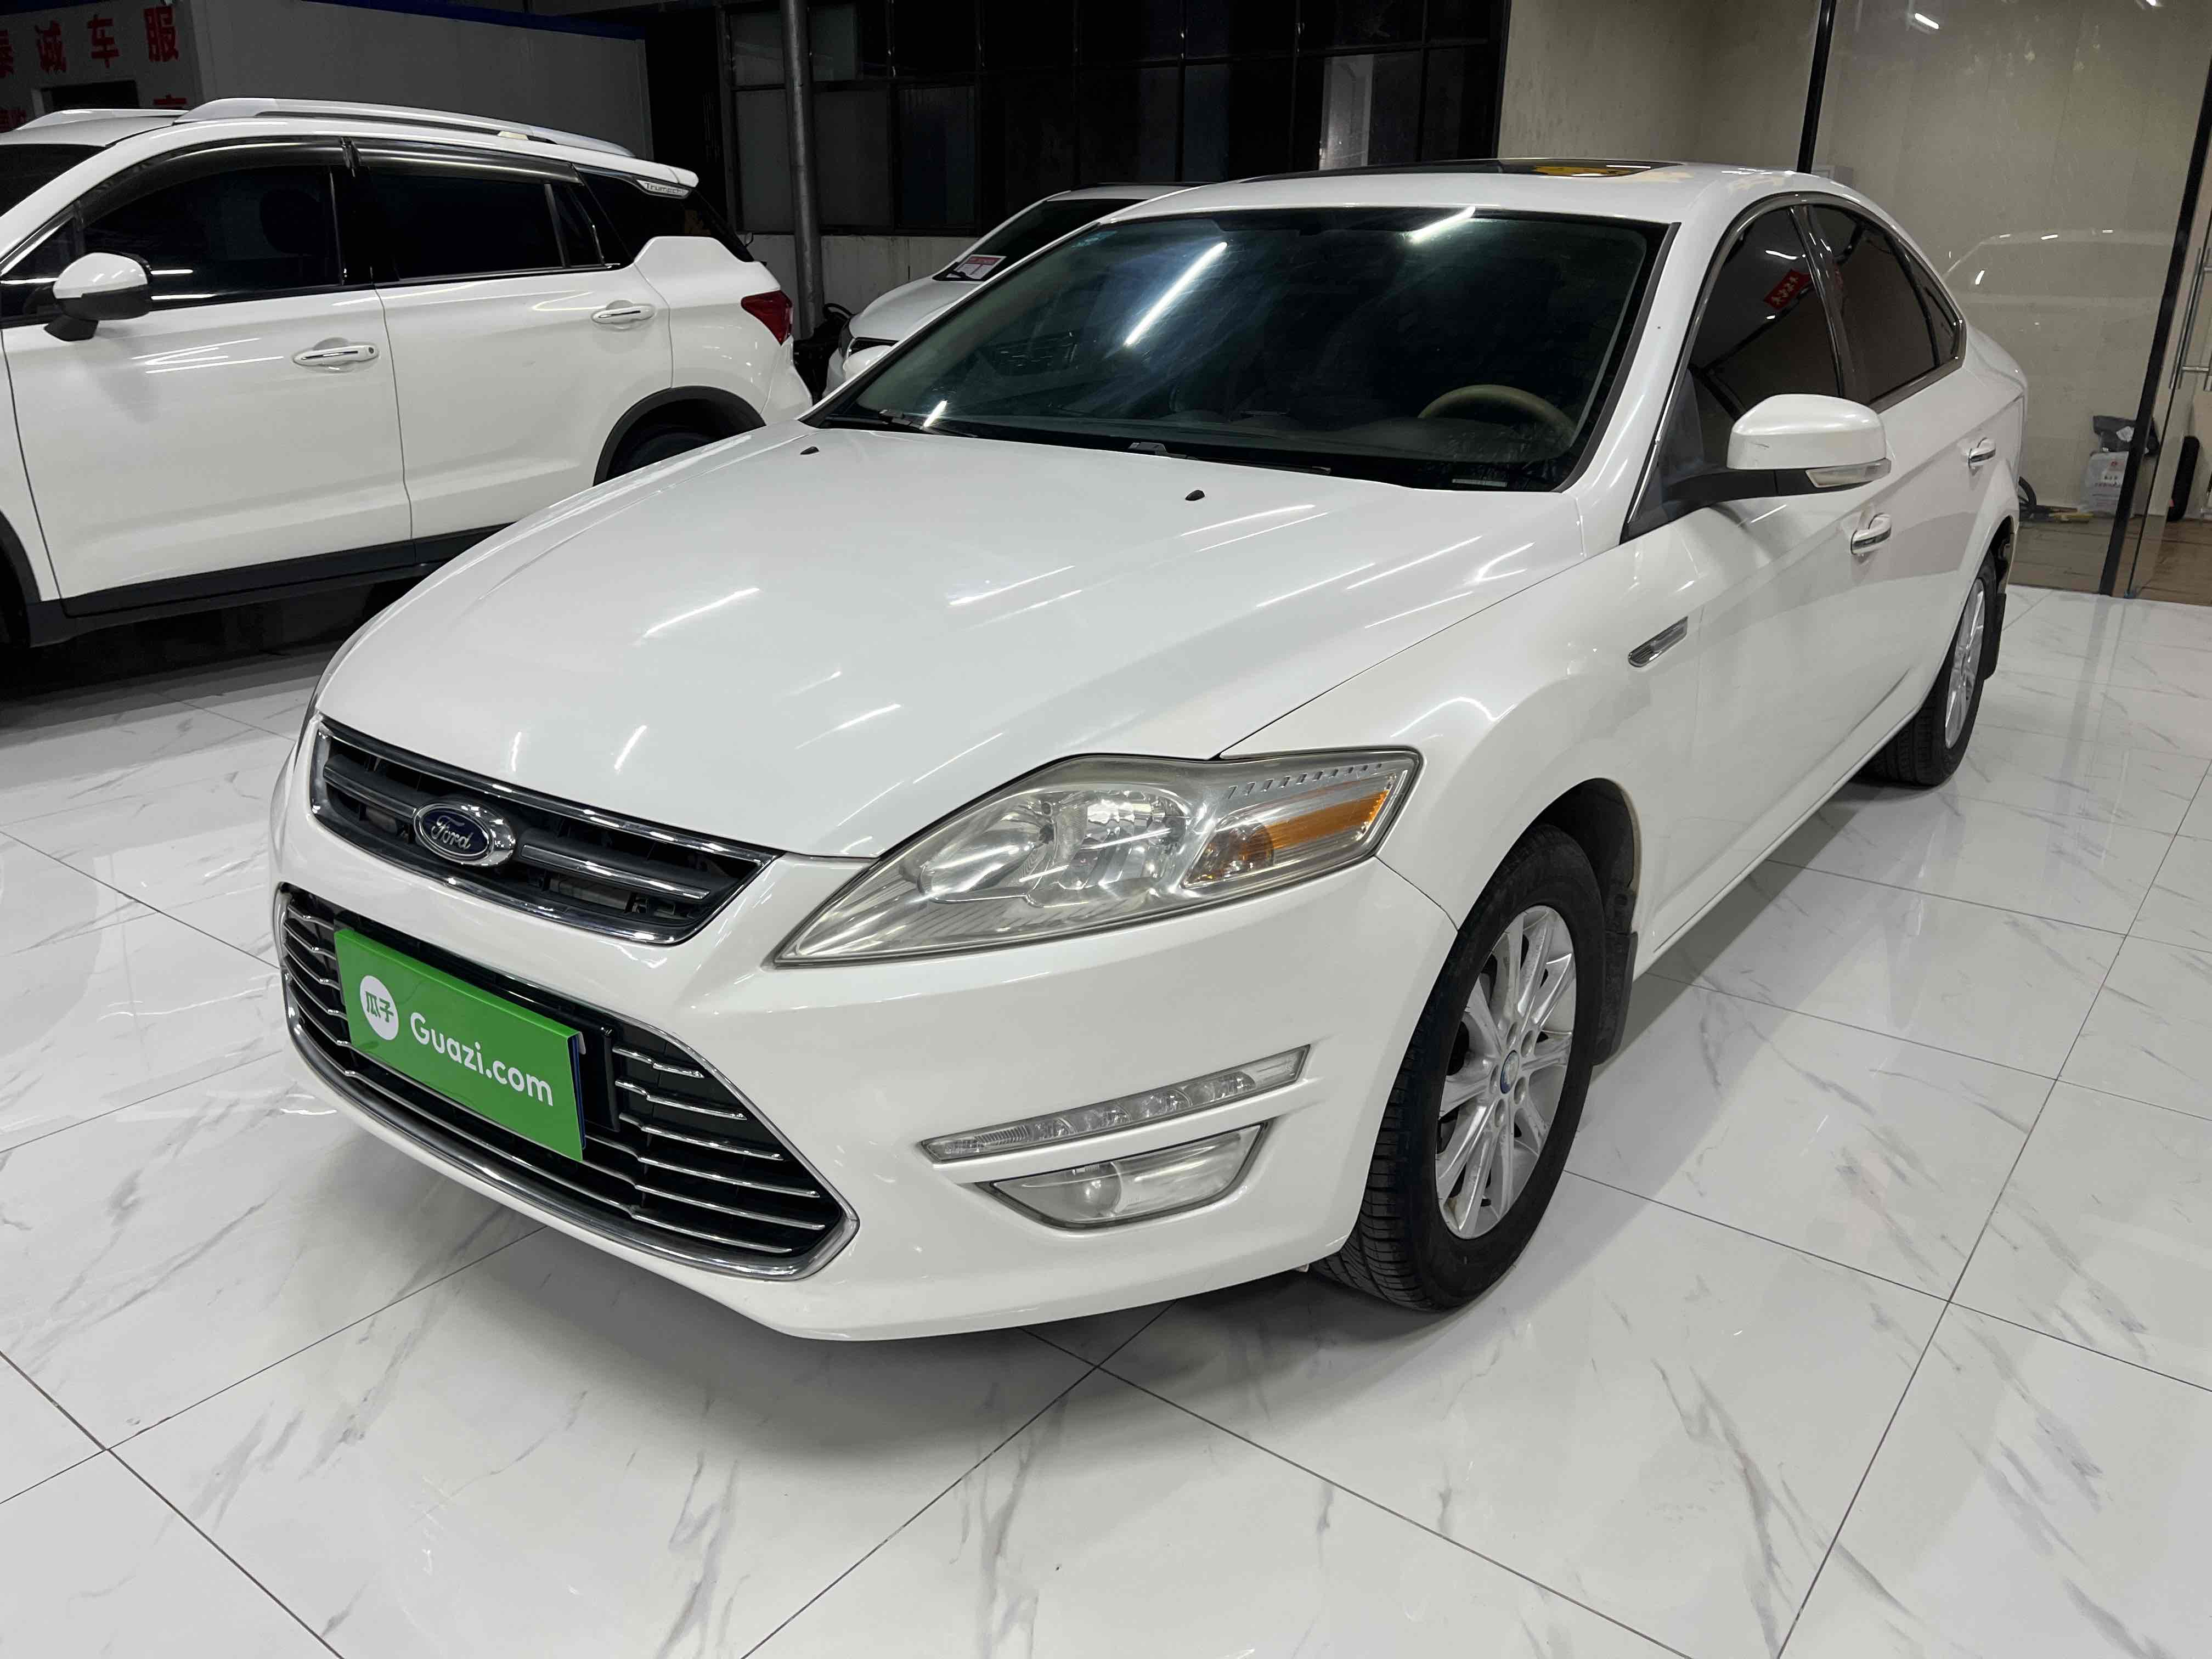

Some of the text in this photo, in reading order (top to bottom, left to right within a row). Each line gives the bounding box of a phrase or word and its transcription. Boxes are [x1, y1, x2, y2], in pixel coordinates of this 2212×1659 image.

[430, 816, 474, 850] Ford
[364, 991, 394, 1023] 瓜子
[410, 1012, 554, 1107] Guazi.com
